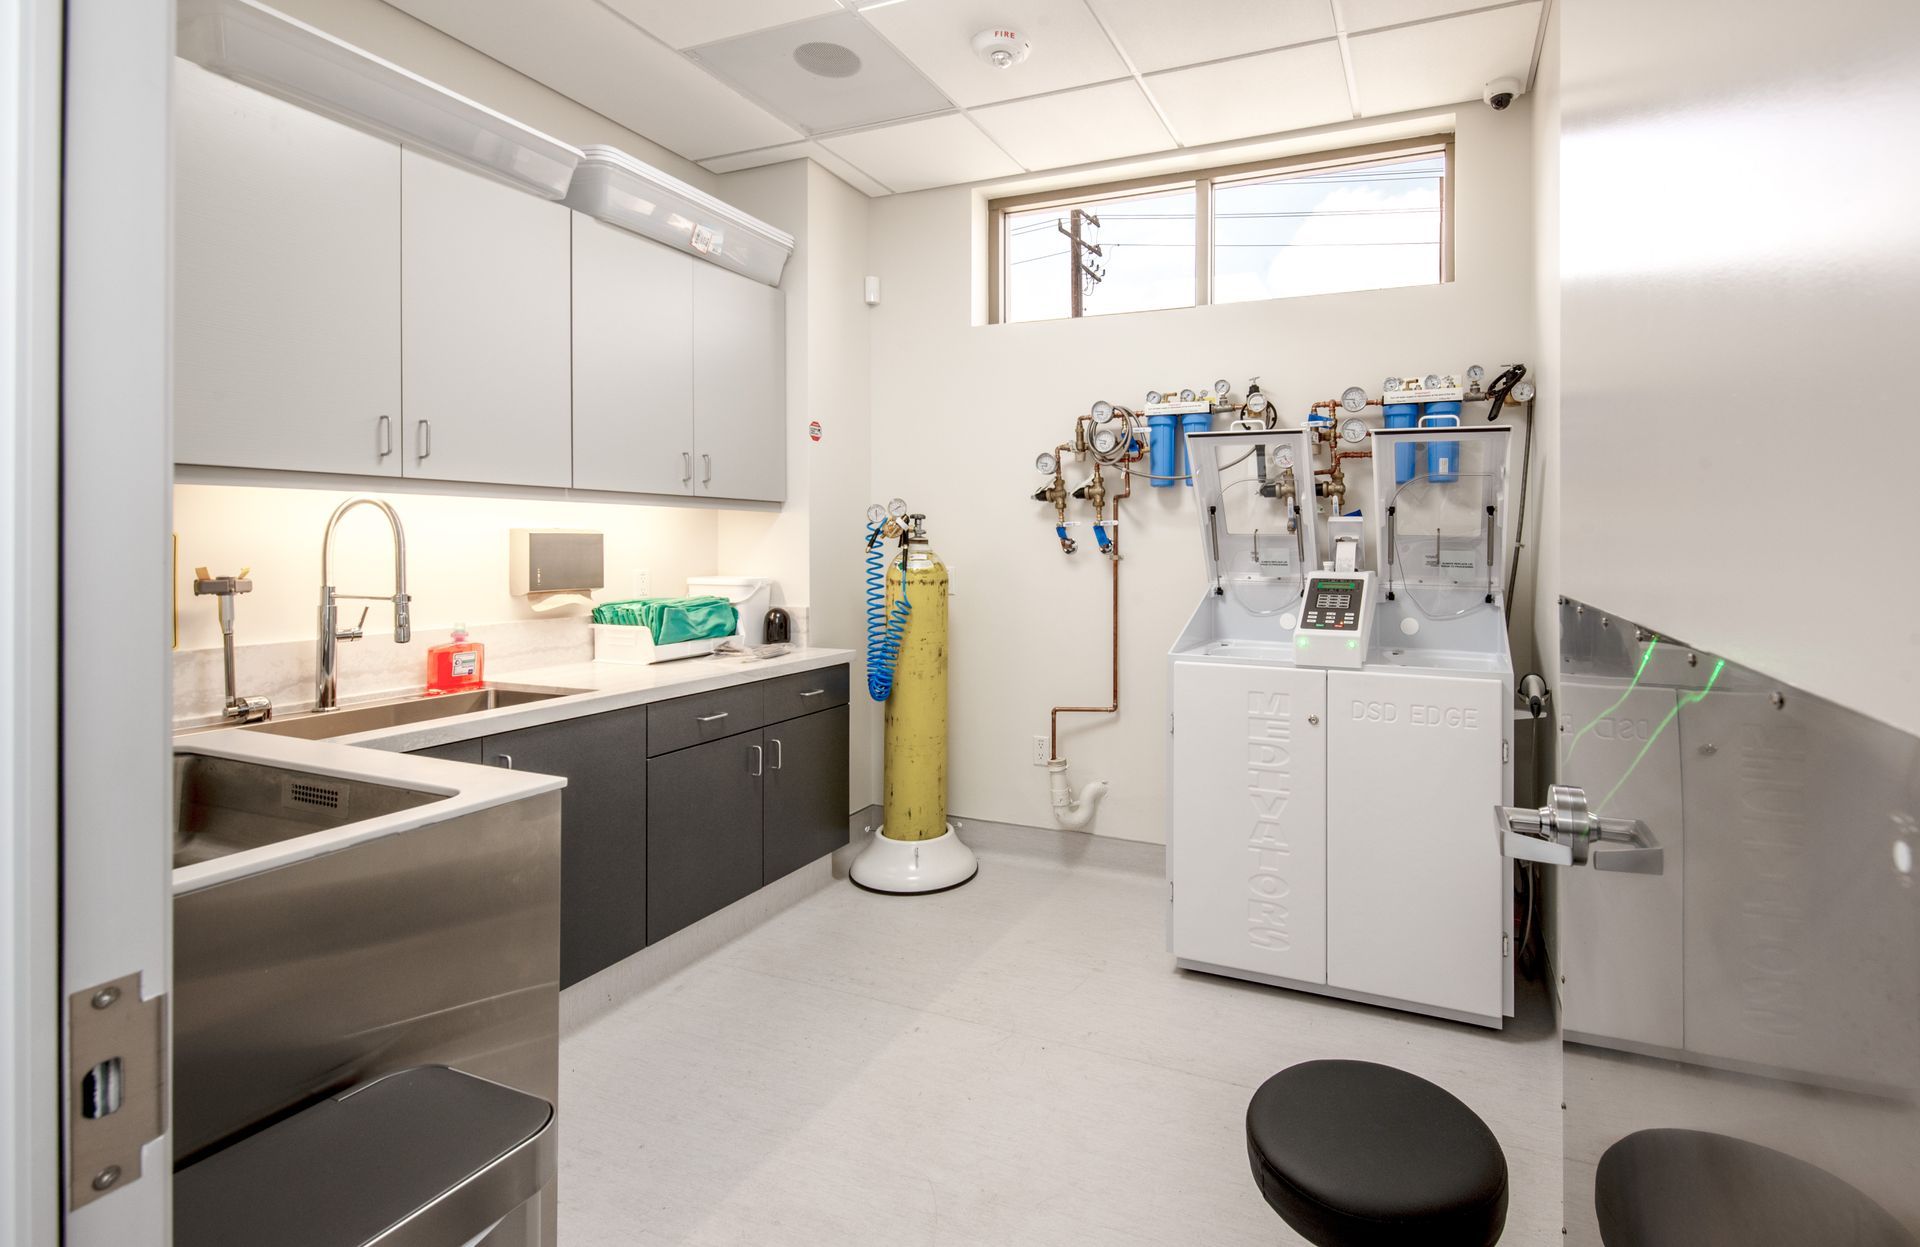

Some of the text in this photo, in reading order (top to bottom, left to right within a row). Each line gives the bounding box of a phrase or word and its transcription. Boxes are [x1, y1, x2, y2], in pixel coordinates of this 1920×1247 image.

[994, 31, 1016, 39] FIRE
[1351, 700, 1479, 729] DSD EDGE
[1248, 690, 1290, 951] MEDIVATORS
